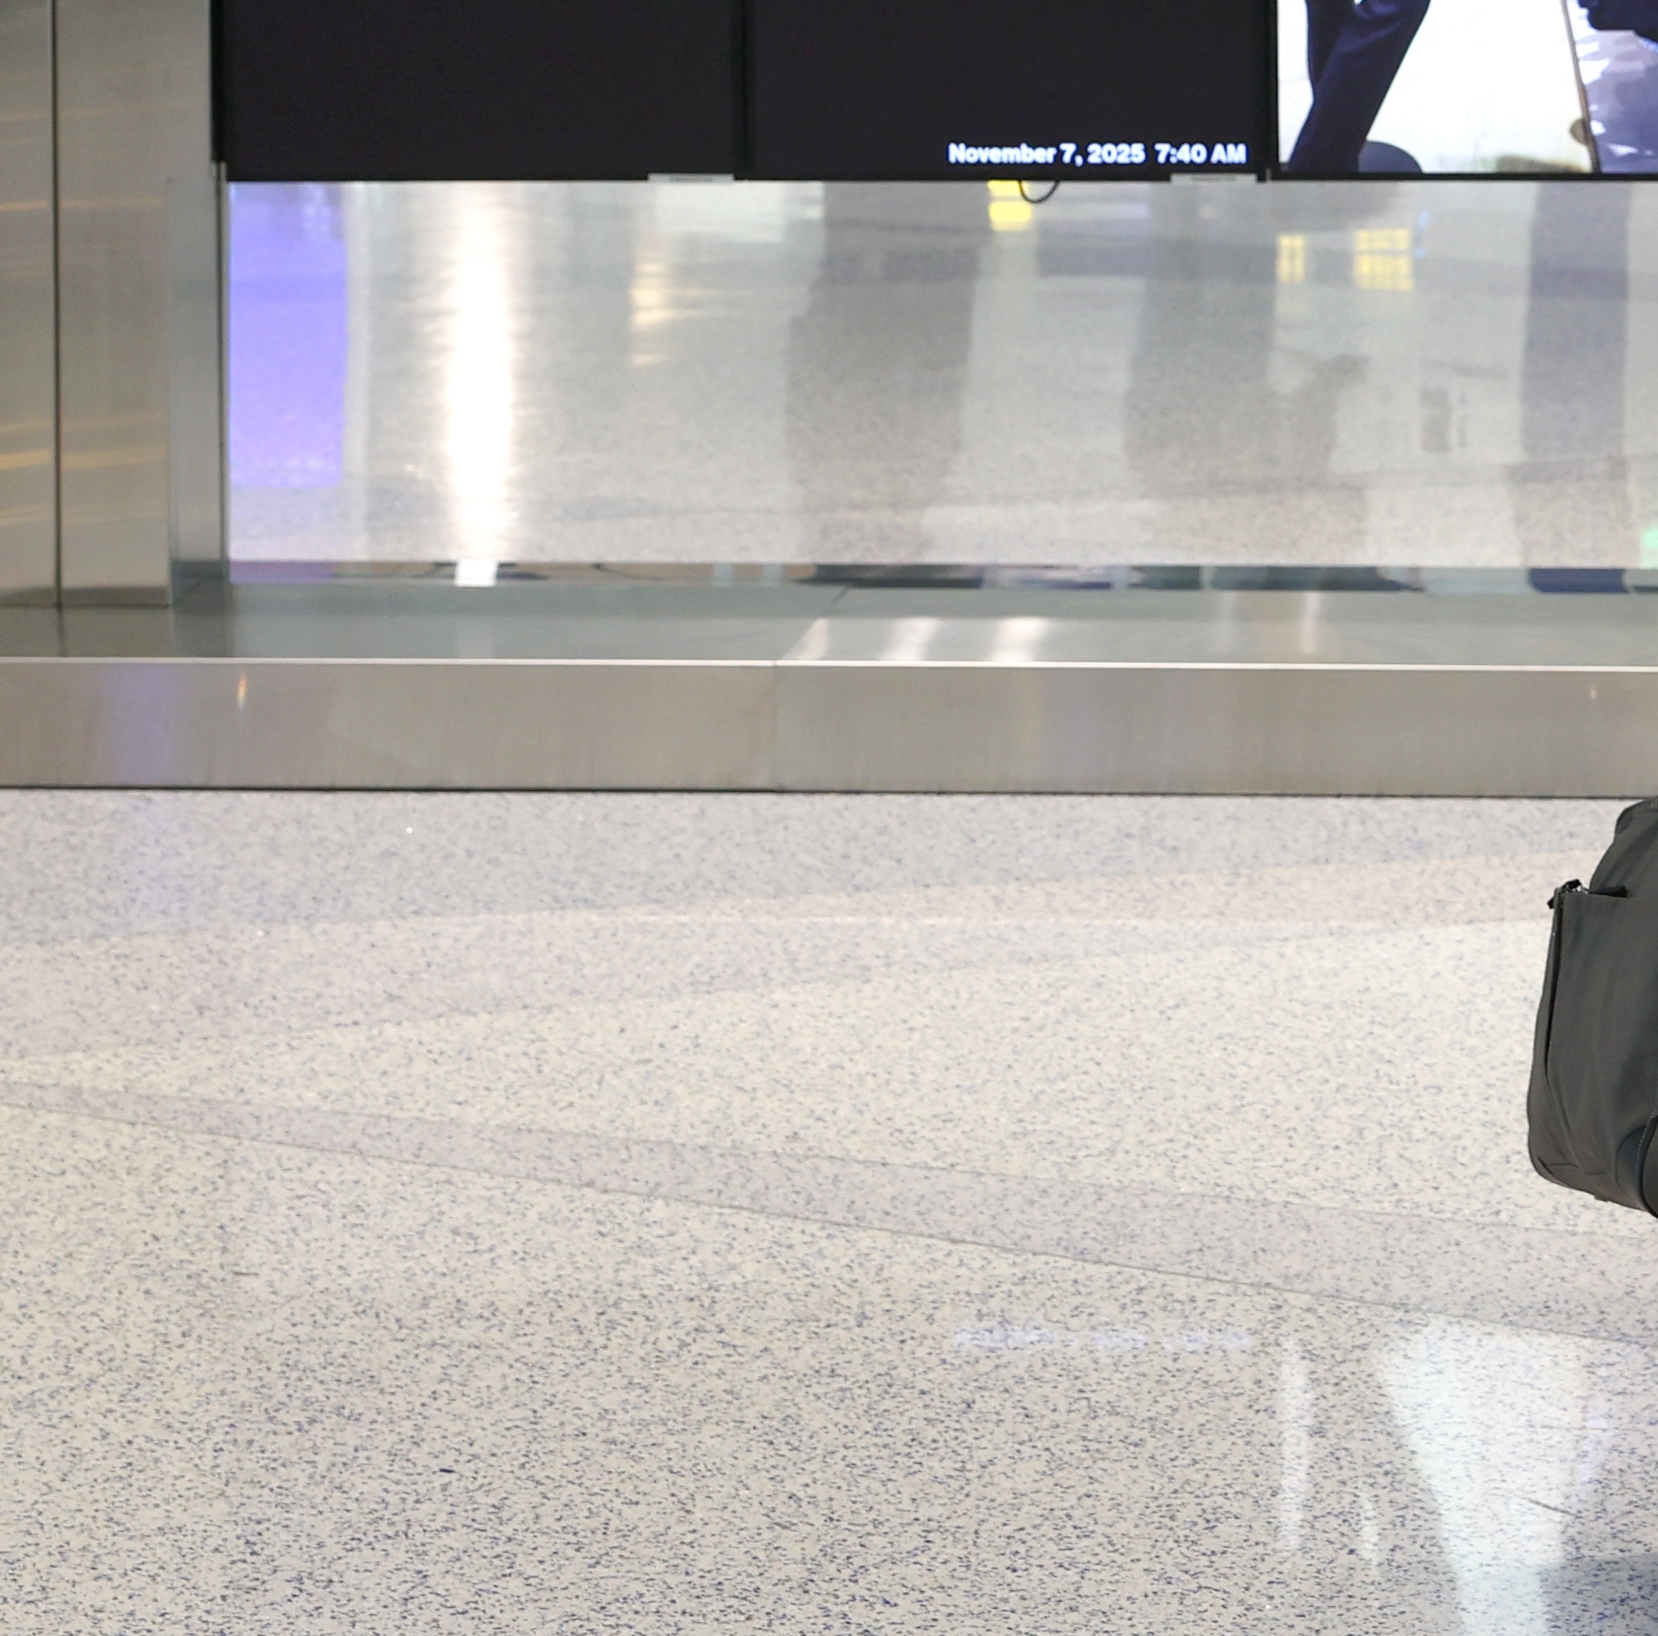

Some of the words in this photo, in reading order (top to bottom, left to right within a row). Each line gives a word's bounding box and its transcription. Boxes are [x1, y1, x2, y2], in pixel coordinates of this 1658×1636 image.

[949, 143, 1057, 163] November
[1060, 143, 1083, 166] 7,
[1088, 143, 1145, 163] 2025
[1155, 143, 1207, 163] 7:40
[1211, 144, 1246, 163] AM
